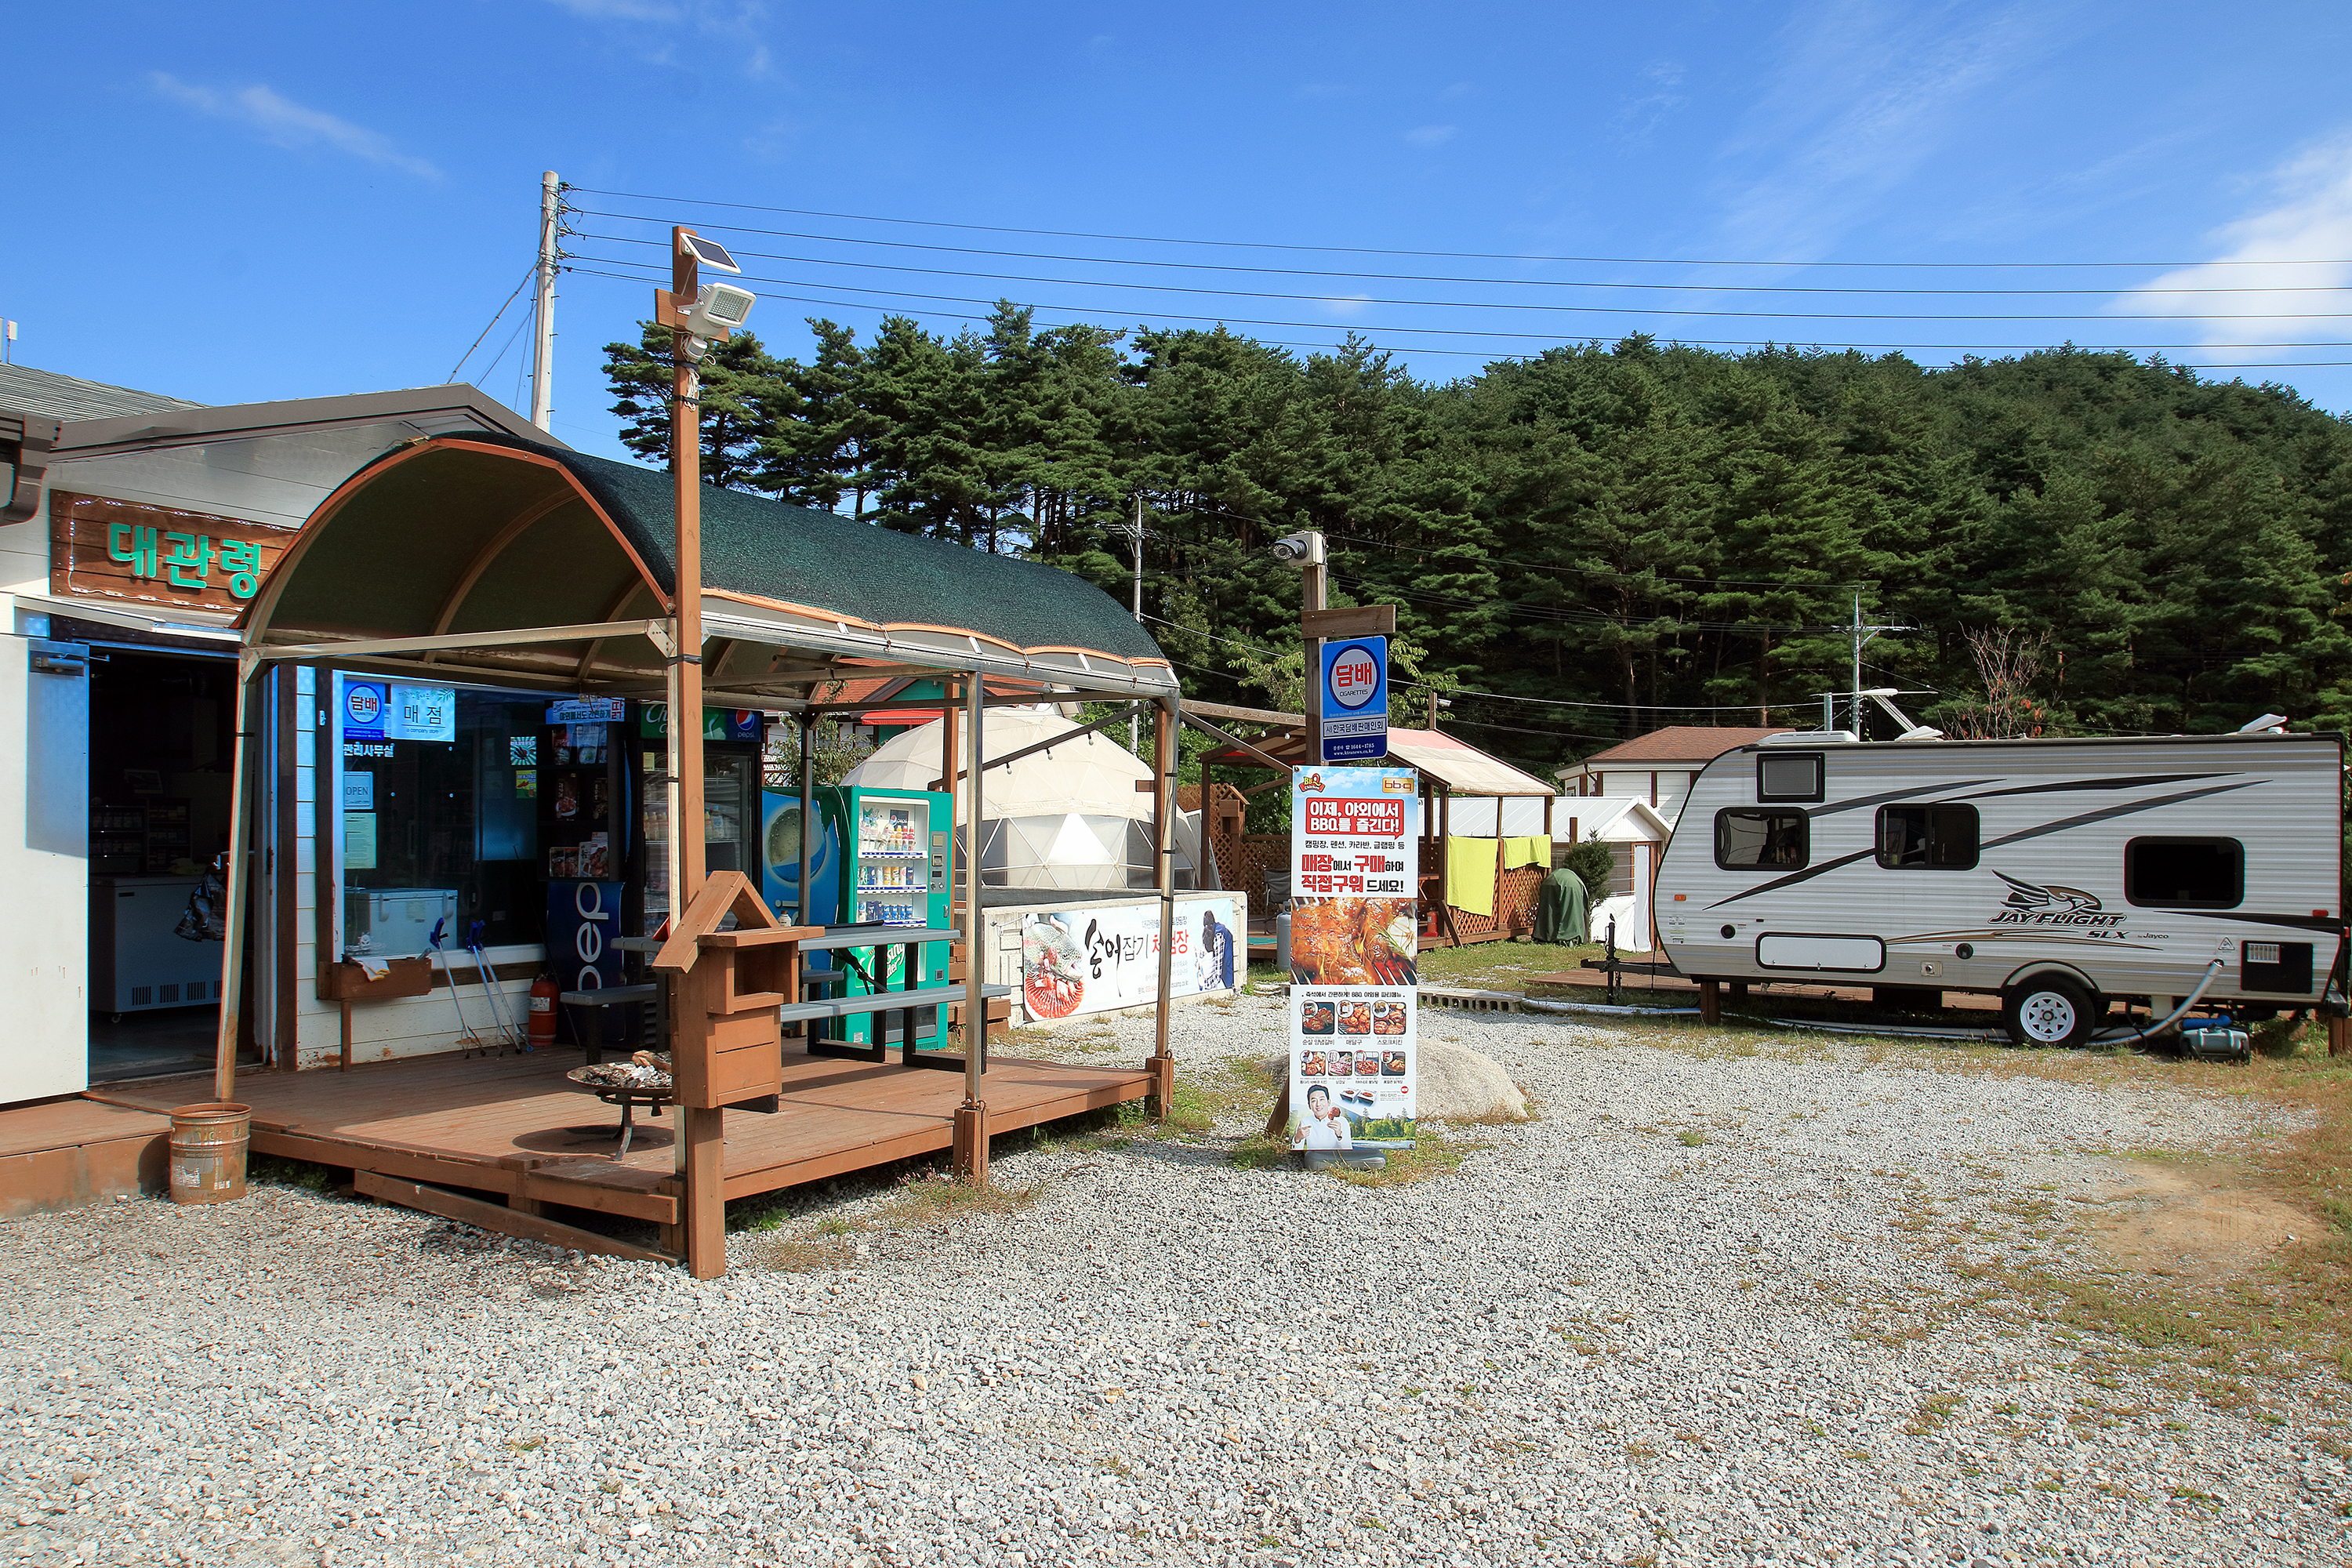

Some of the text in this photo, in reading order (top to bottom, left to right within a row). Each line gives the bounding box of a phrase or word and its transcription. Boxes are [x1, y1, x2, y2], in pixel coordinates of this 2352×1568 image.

[107, 522, 261, 598] 대관령
[1336, 662, 1372, 687] 담배
[350, 695, 378, 712] 담배
[559, 710, 587, 720] 야외에서도
[343, 743, 394, 757] 관리사무실
[346, 786, 368, 796] OPEN
[1310, 801, 1399, 818] 이제, 야외에서
[1310, 818, 1399, 833] BBQ를 즐긴다!
[1301, 855, 1403, 872] 매장에서 구매하여
[1301, 875, 1403, 892] 직접구워 드세요!
[1987, 910, 2127, 927] JAY FLIGHT
[2086, 931, 2130, 939] SLX
